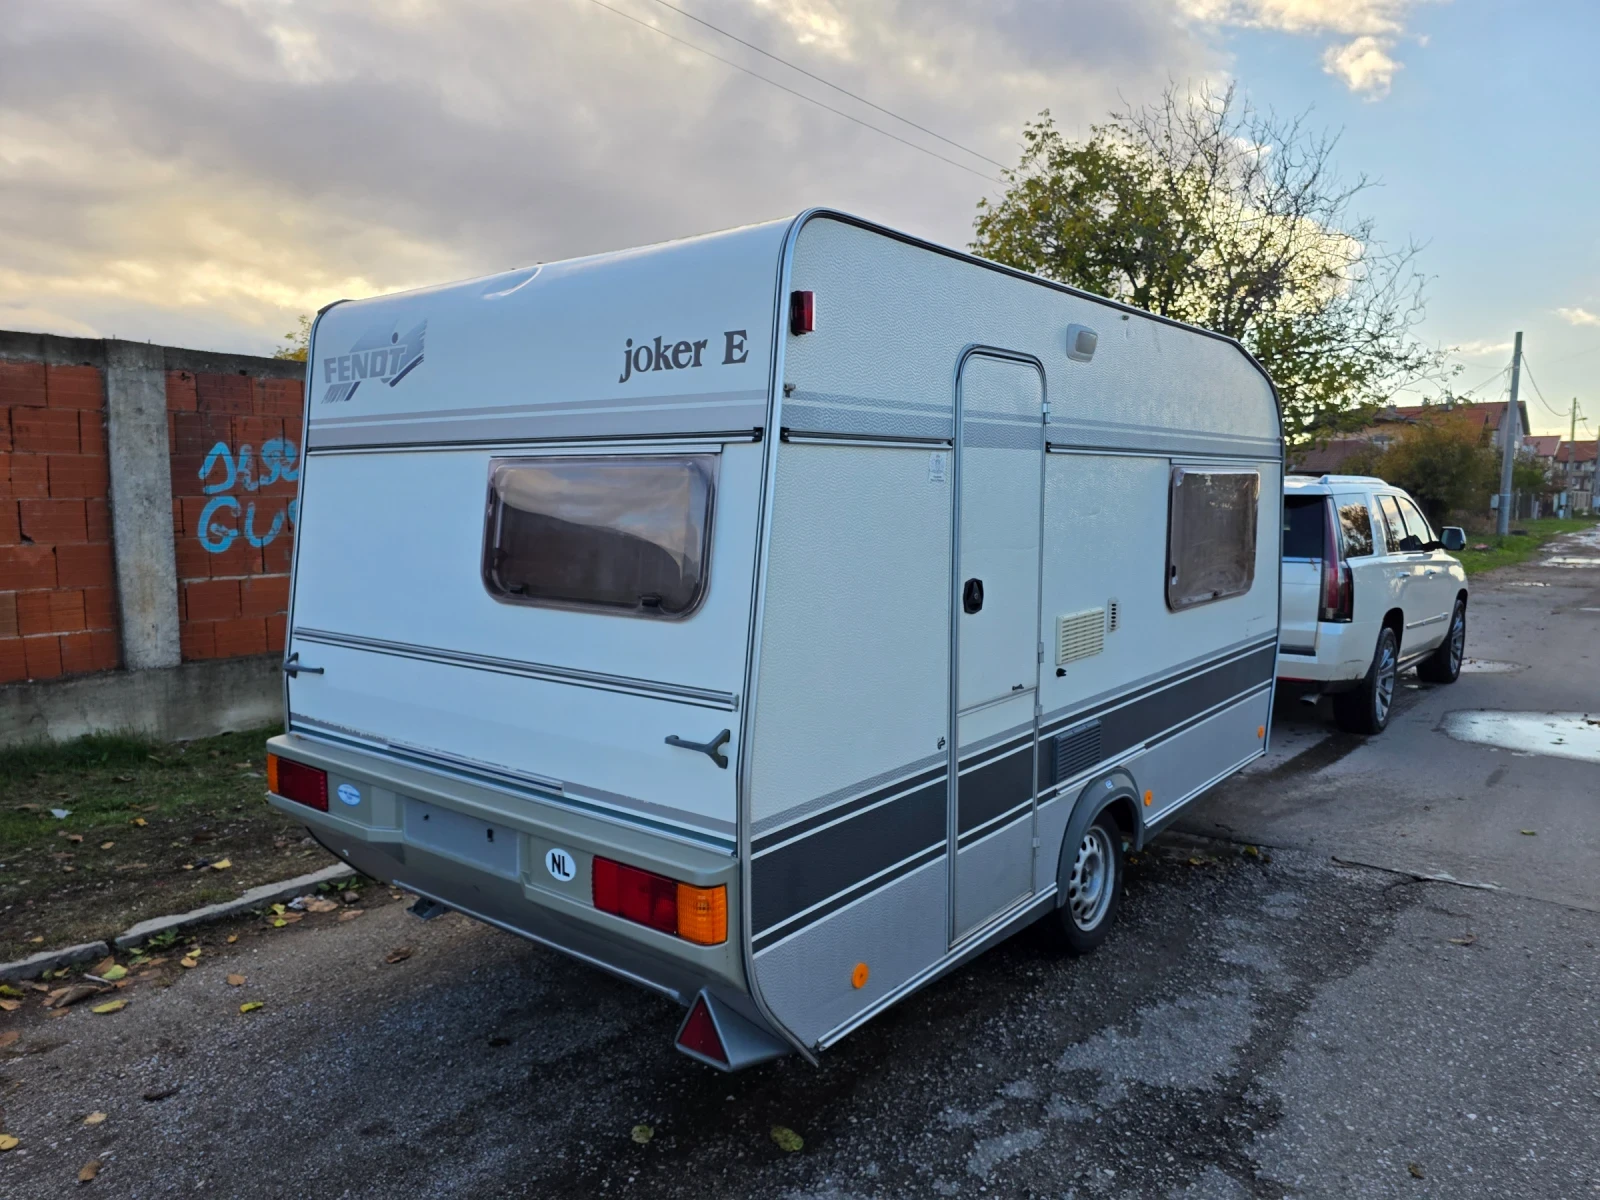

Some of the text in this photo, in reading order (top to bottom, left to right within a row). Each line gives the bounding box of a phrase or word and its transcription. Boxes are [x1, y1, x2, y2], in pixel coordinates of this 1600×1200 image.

[323, 346, 407, 384] FENDT
[618, 329, 749, 384] joker E
[551, 852, 570, 878] NL
